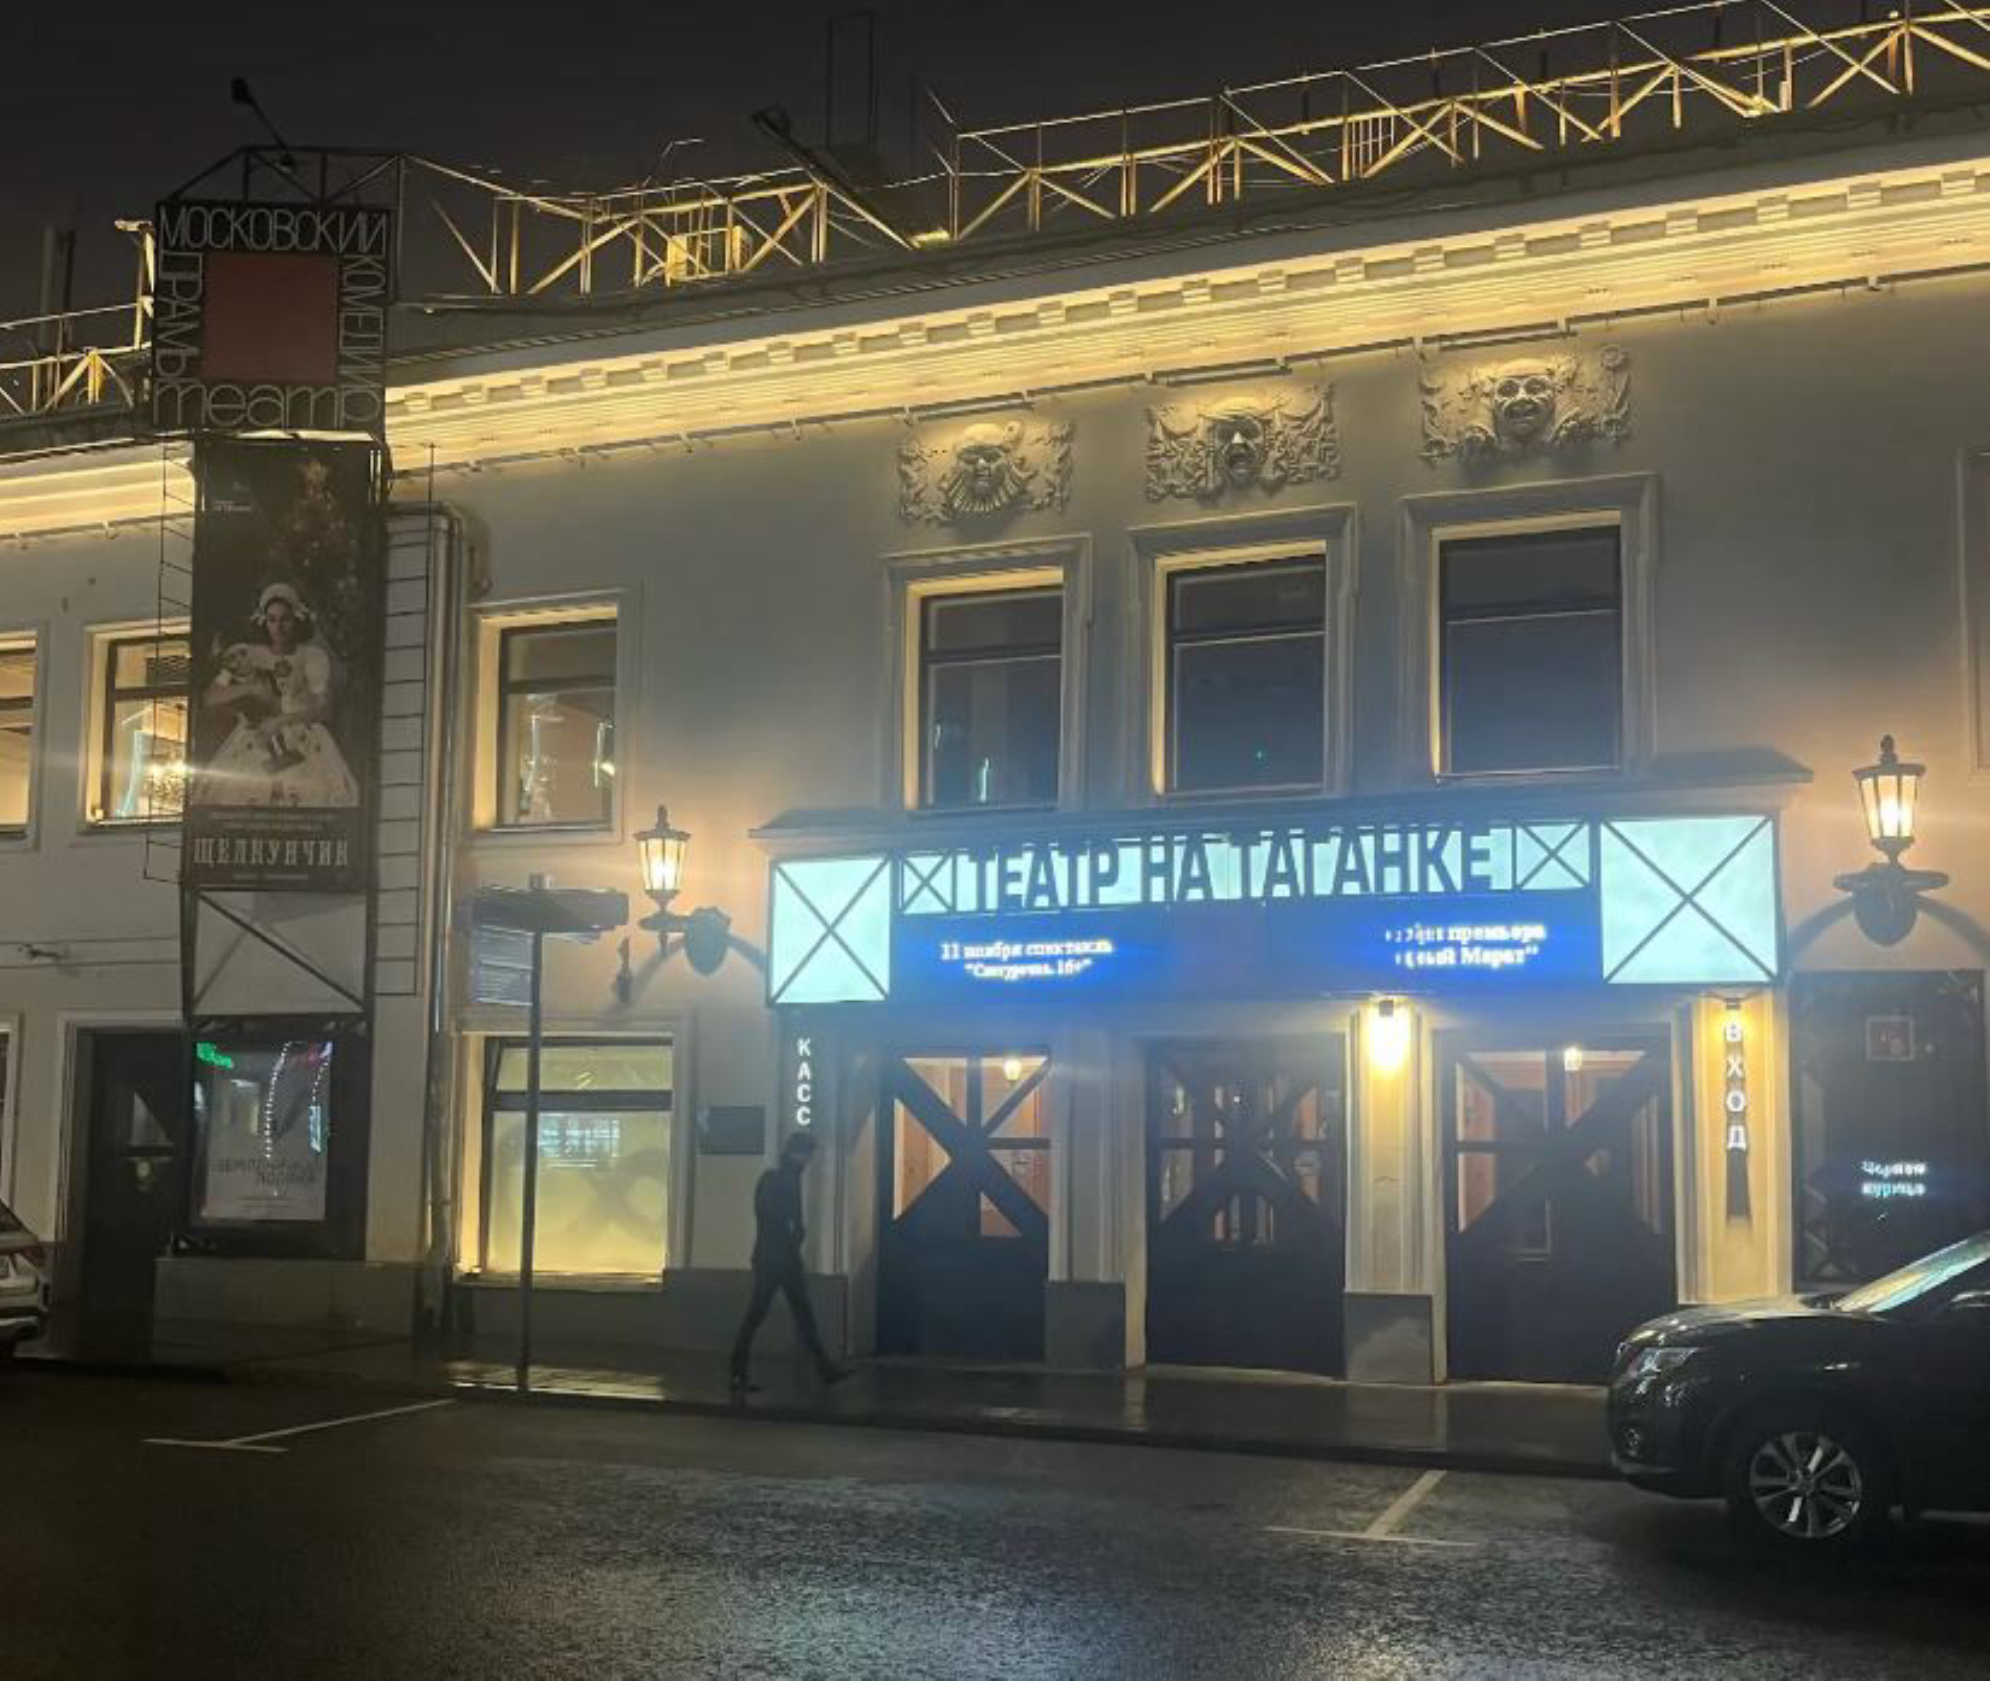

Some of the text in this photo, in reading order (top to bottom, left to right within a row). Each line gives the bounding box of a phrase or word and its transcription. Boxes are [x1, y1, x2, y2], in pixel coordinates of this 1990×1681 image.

[159, 206, 387, 251] МОСКОВСКИЙ
[193, 837, 348, 868] ЩЕЛКУНЧИК
[968, 825, 1491, 912] ТЕАТР НА ТАГАНКЕ
[941, 942, 961, 961] 11
[796, 1037, 811, 1126] КАСС
[1726, 1021, 1747, 1150] ВХОД
